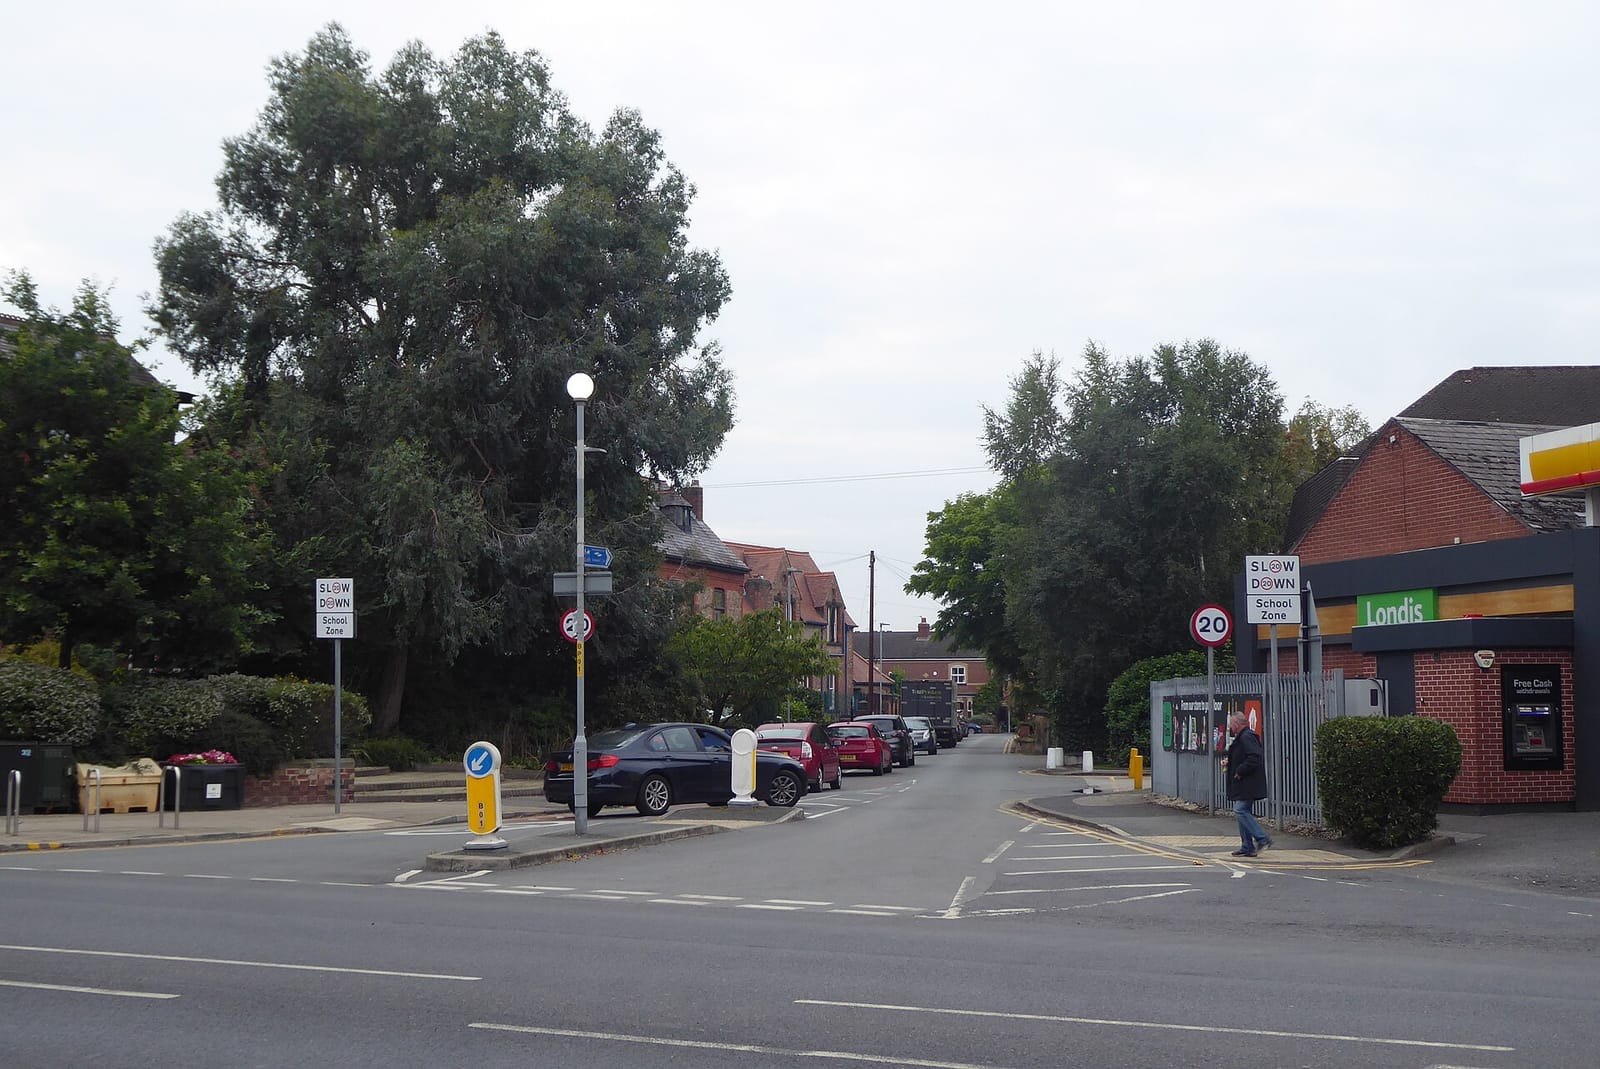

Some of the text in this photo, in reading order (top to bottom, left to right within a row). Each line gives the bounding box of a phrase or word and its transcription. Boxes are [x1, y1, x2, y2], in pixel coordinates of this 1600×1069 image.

[1251, 560, 1294, 573] SLOW
[320, 582, 350, 594] SLOW
[1252, 577, 1295, 590] DOWN
[320, 597, 350, 609] DOWN
[1256, 599, 1292, 608] School
[1261, 610, 1287, 620] Zone
[1366, 597, 1423, 626] Londis
[322, 616, 347, 625] School
[1199, 616, 1226, 633] 20
[326, 626, 344, 635] Zone
[1513, 679, 1553, 688] Free Cash
